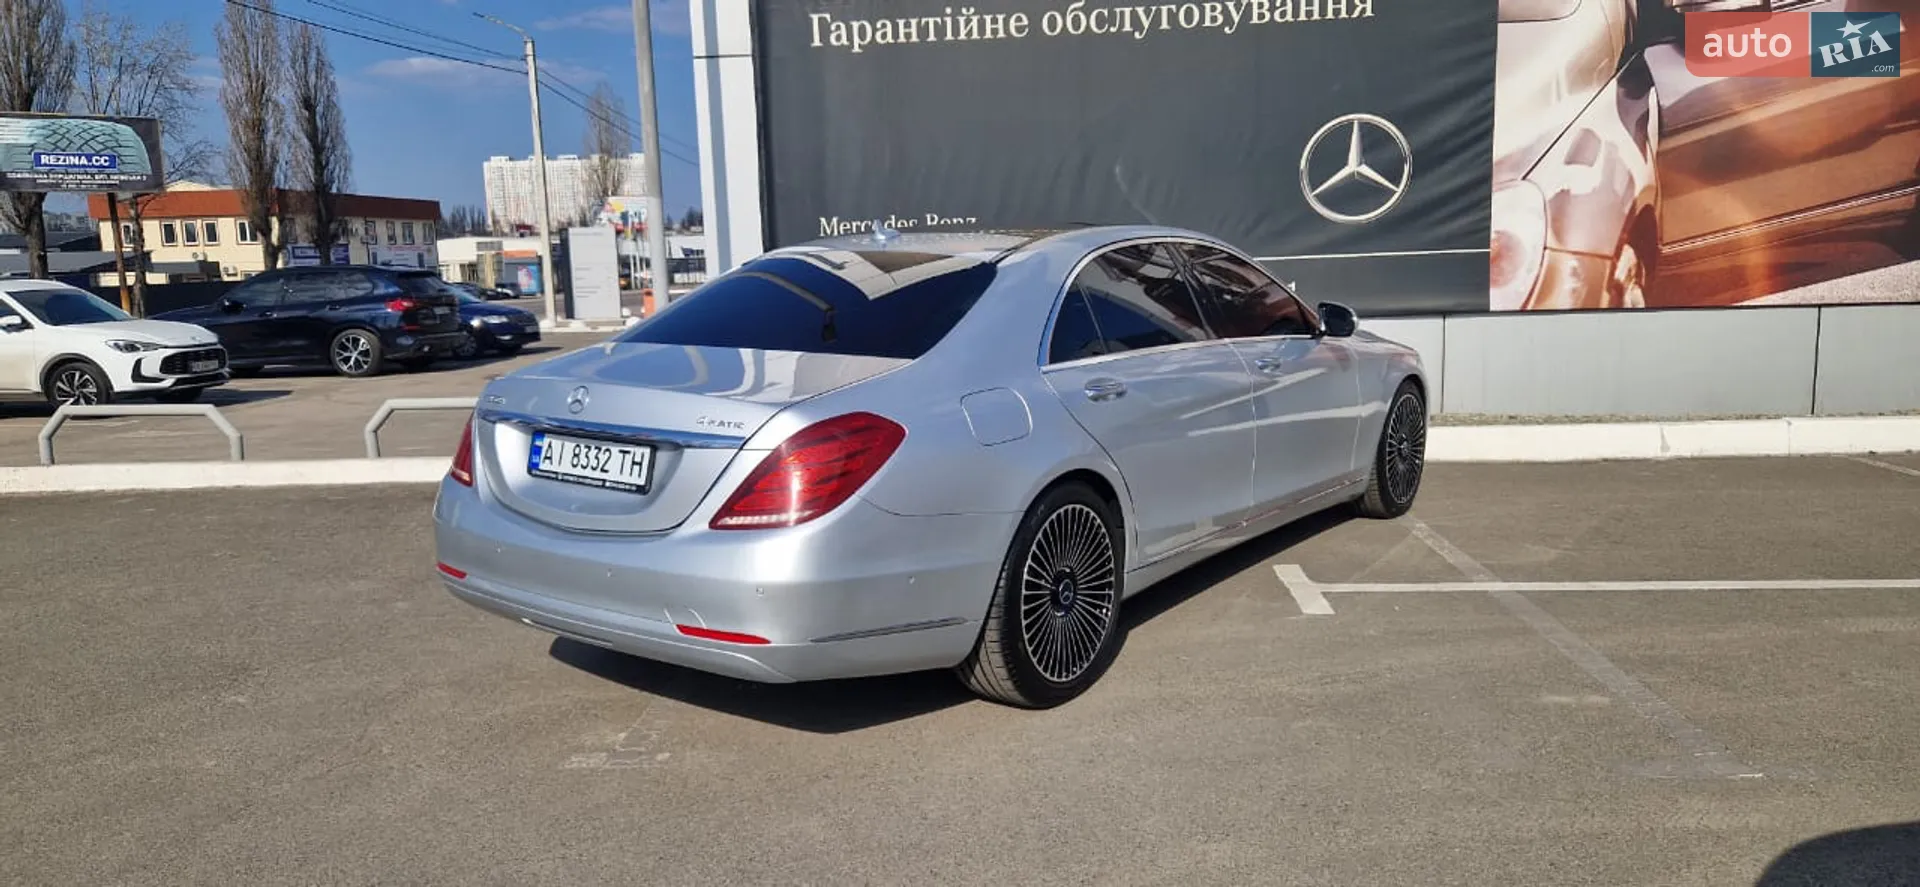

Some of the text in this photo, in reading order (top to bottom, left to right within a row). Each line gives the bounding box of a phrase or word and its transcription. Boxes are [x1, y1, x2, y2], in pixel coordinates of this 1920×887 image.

[809, 0, 1375, 52] Гарантійне обслуговування
[40, 154, 110, 166] REZINA.CC
[819, 215, 918, 236] Mercdes
[571, 443, 612, 473] 8332
[618, 448, 645, 478] TH
